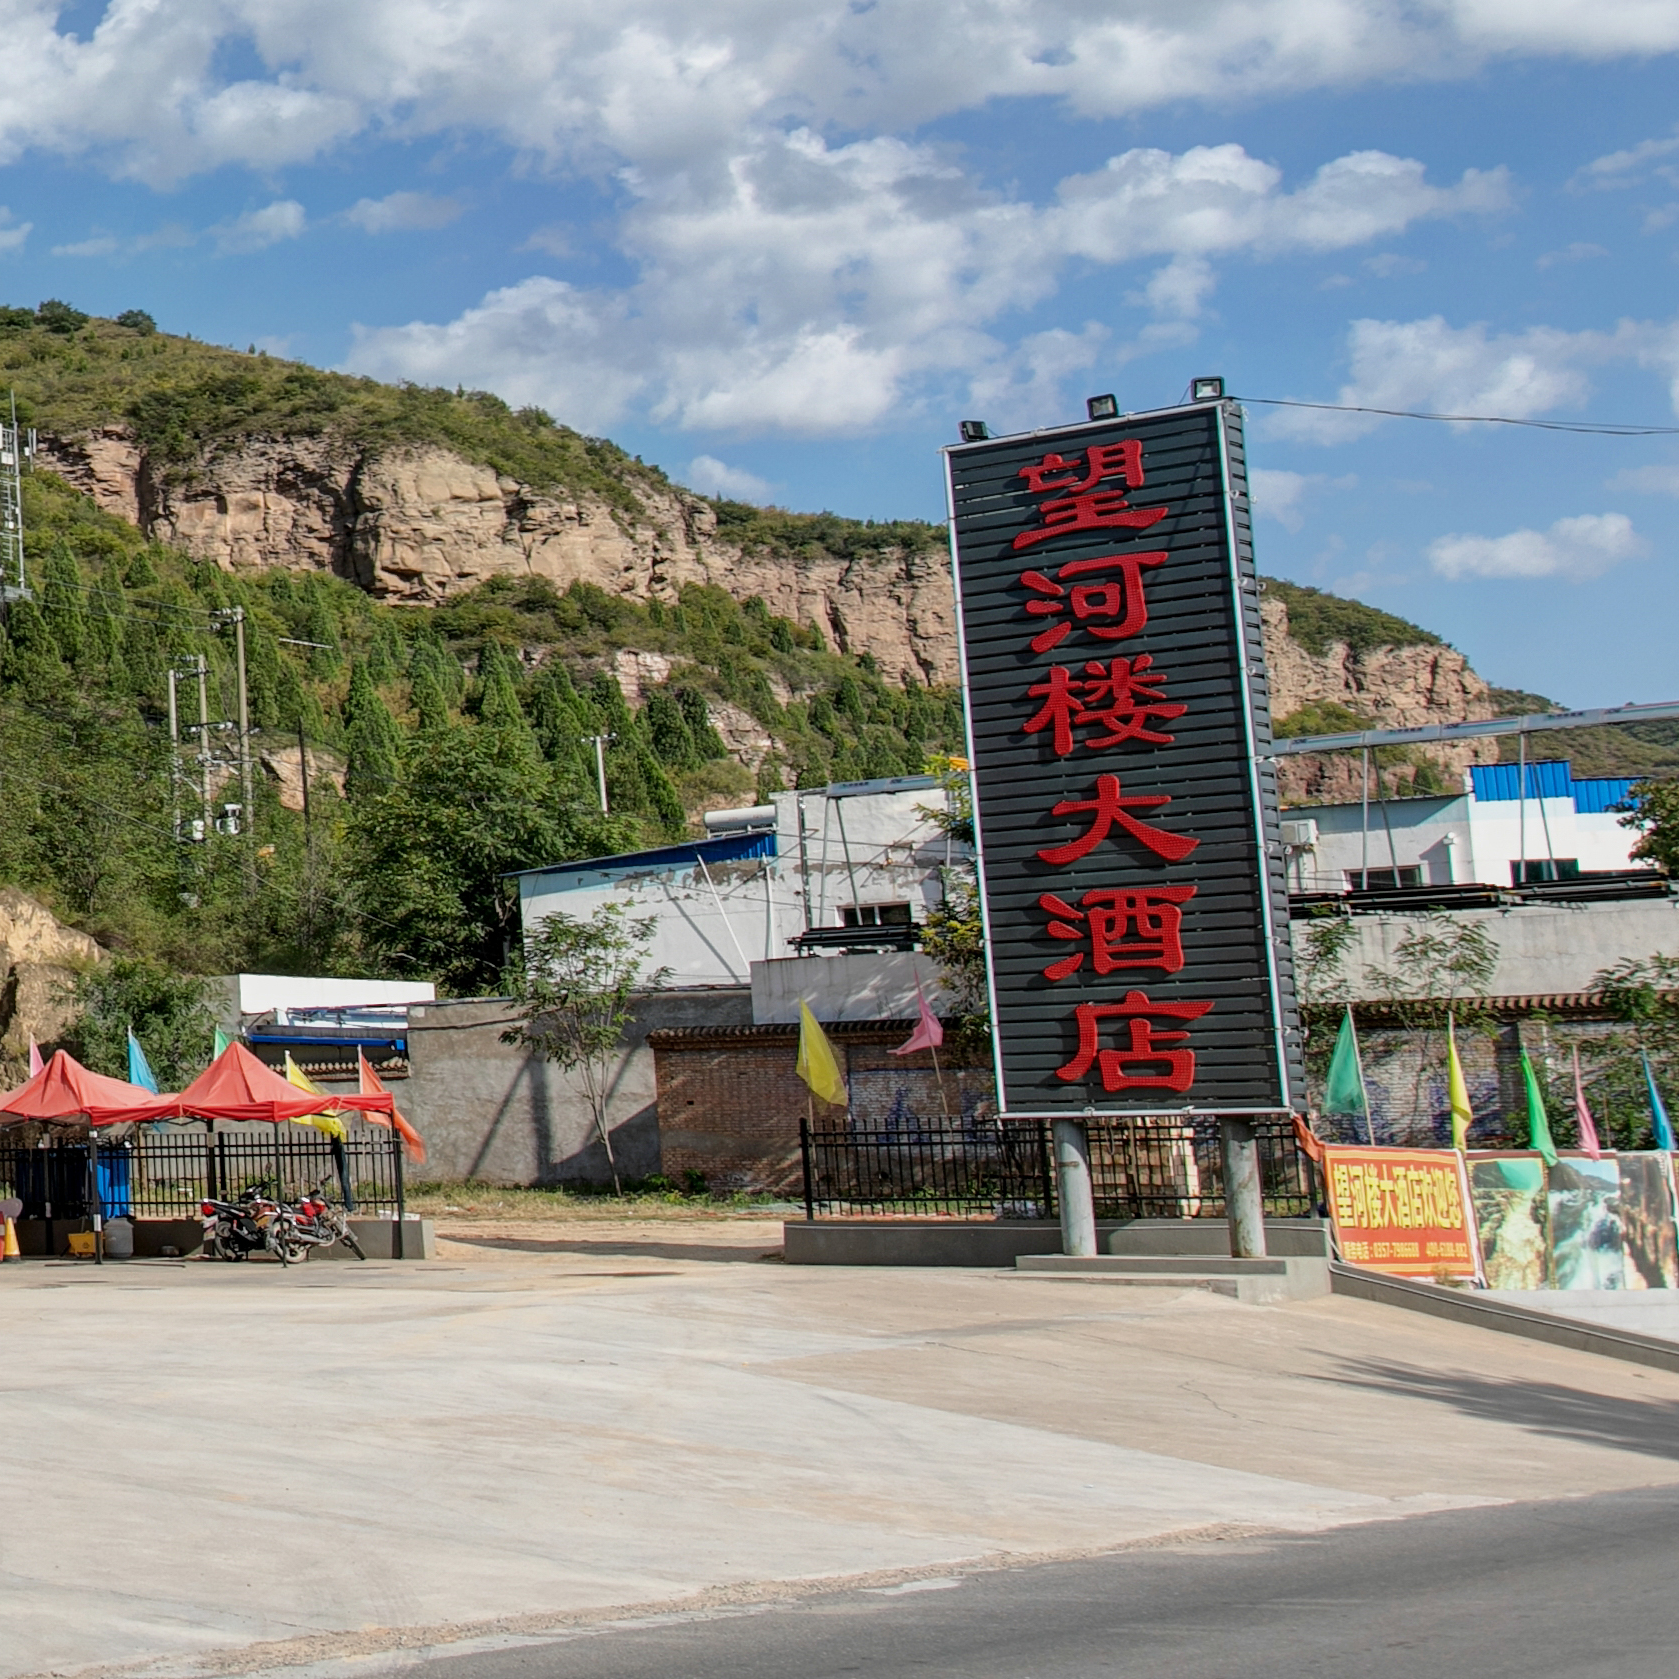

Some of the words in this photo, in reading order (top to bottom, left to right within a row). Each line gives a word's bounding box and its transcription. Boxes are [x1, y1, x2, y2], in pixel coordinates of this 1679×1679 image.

[1012, 438, 1215, 1092] 望河楼大酒店
